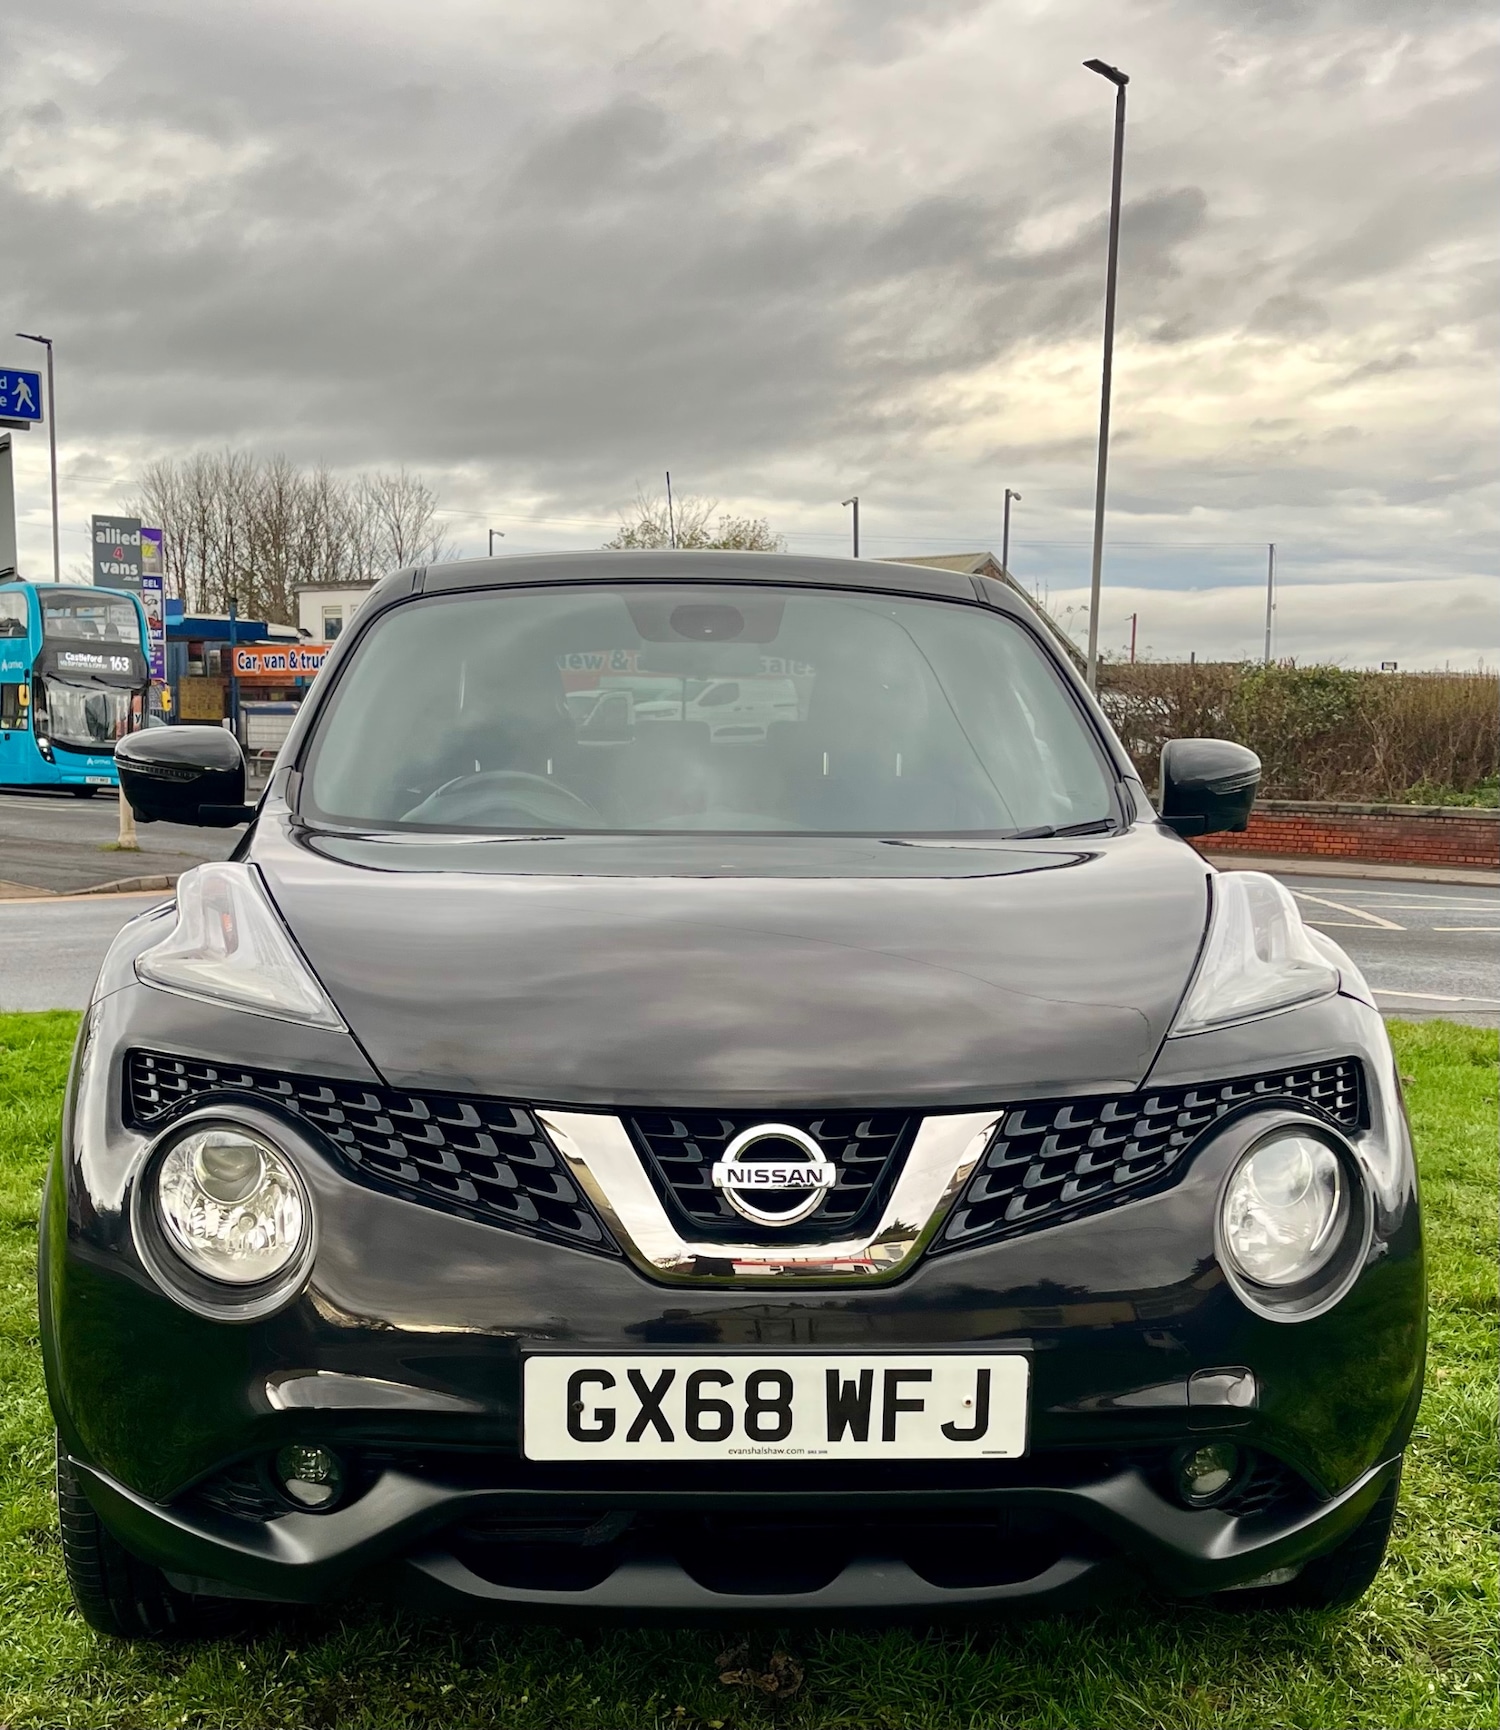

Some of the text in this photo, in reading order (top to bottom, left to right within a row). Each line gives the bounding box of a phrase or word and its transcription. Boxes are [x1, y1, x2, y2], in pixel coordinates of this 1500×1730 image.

[95, 528, 141, 546] allied
[112, 546, 124, 561] 4
[100, 561, 139, 576] vans
[65, 651, 103, 664] Castleford
[110, 655, 130, 672] 163
[264, 655, 286, 669] van
[289, 651, 298, 669] &
[727, 1169, 823, 1183] NISSAN
[566, 1369, 991, 1442] GX68 WFJ
[728, 1447, 805, 1455] evanshalshaw.com
